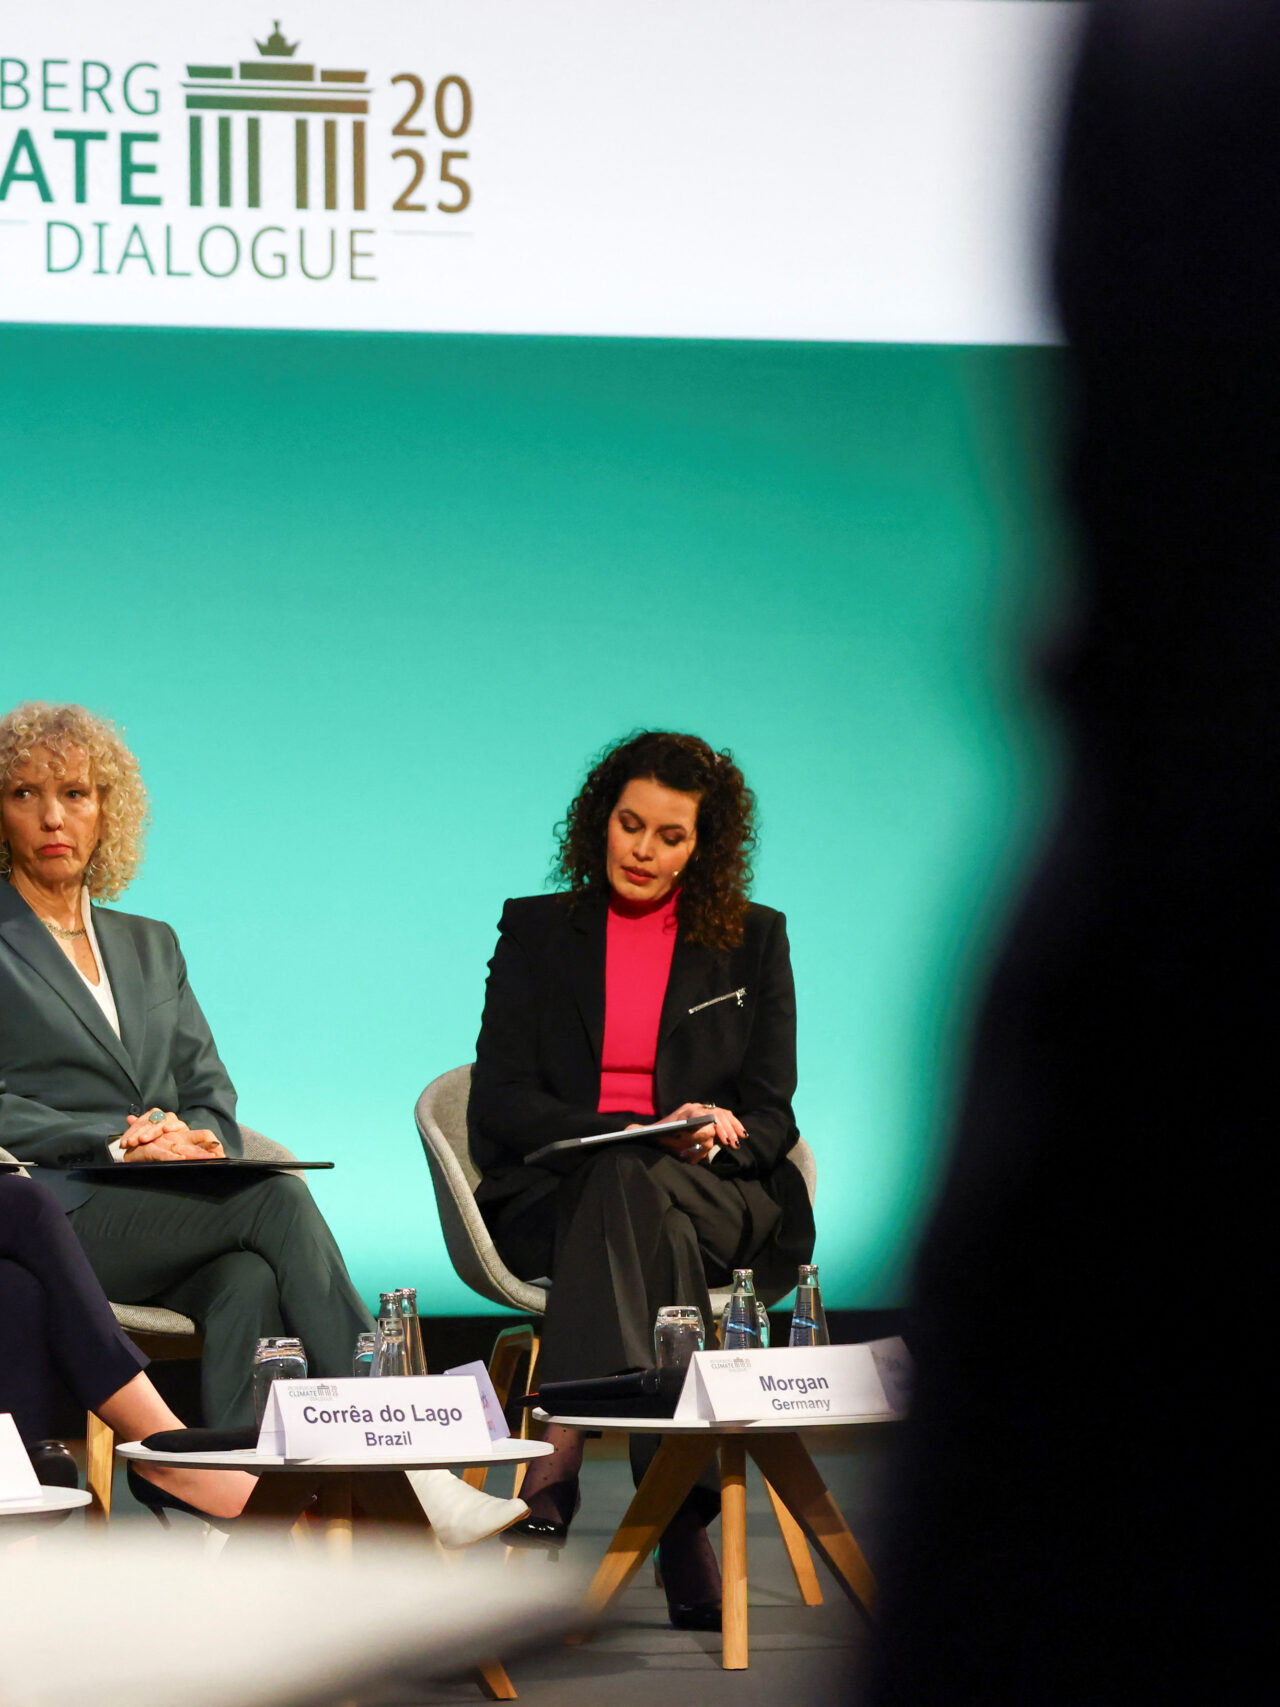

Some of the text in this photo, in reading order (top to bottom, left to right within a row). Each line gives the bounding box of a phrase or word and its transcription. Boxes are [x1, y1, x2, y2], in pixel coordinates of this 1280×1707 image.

[390, 73, 473, 139] 20
[391, 148, 473, 213] 25
[46, 221, 378, 281] DIALOGUE
[759, 1375, 829, 1394] Morgan
[303, 1404, 462, 1426] Corrêa do Lago
[771, 1398, 831, 1411] Germany
[365, 1431, 412, 1446] Brazil
